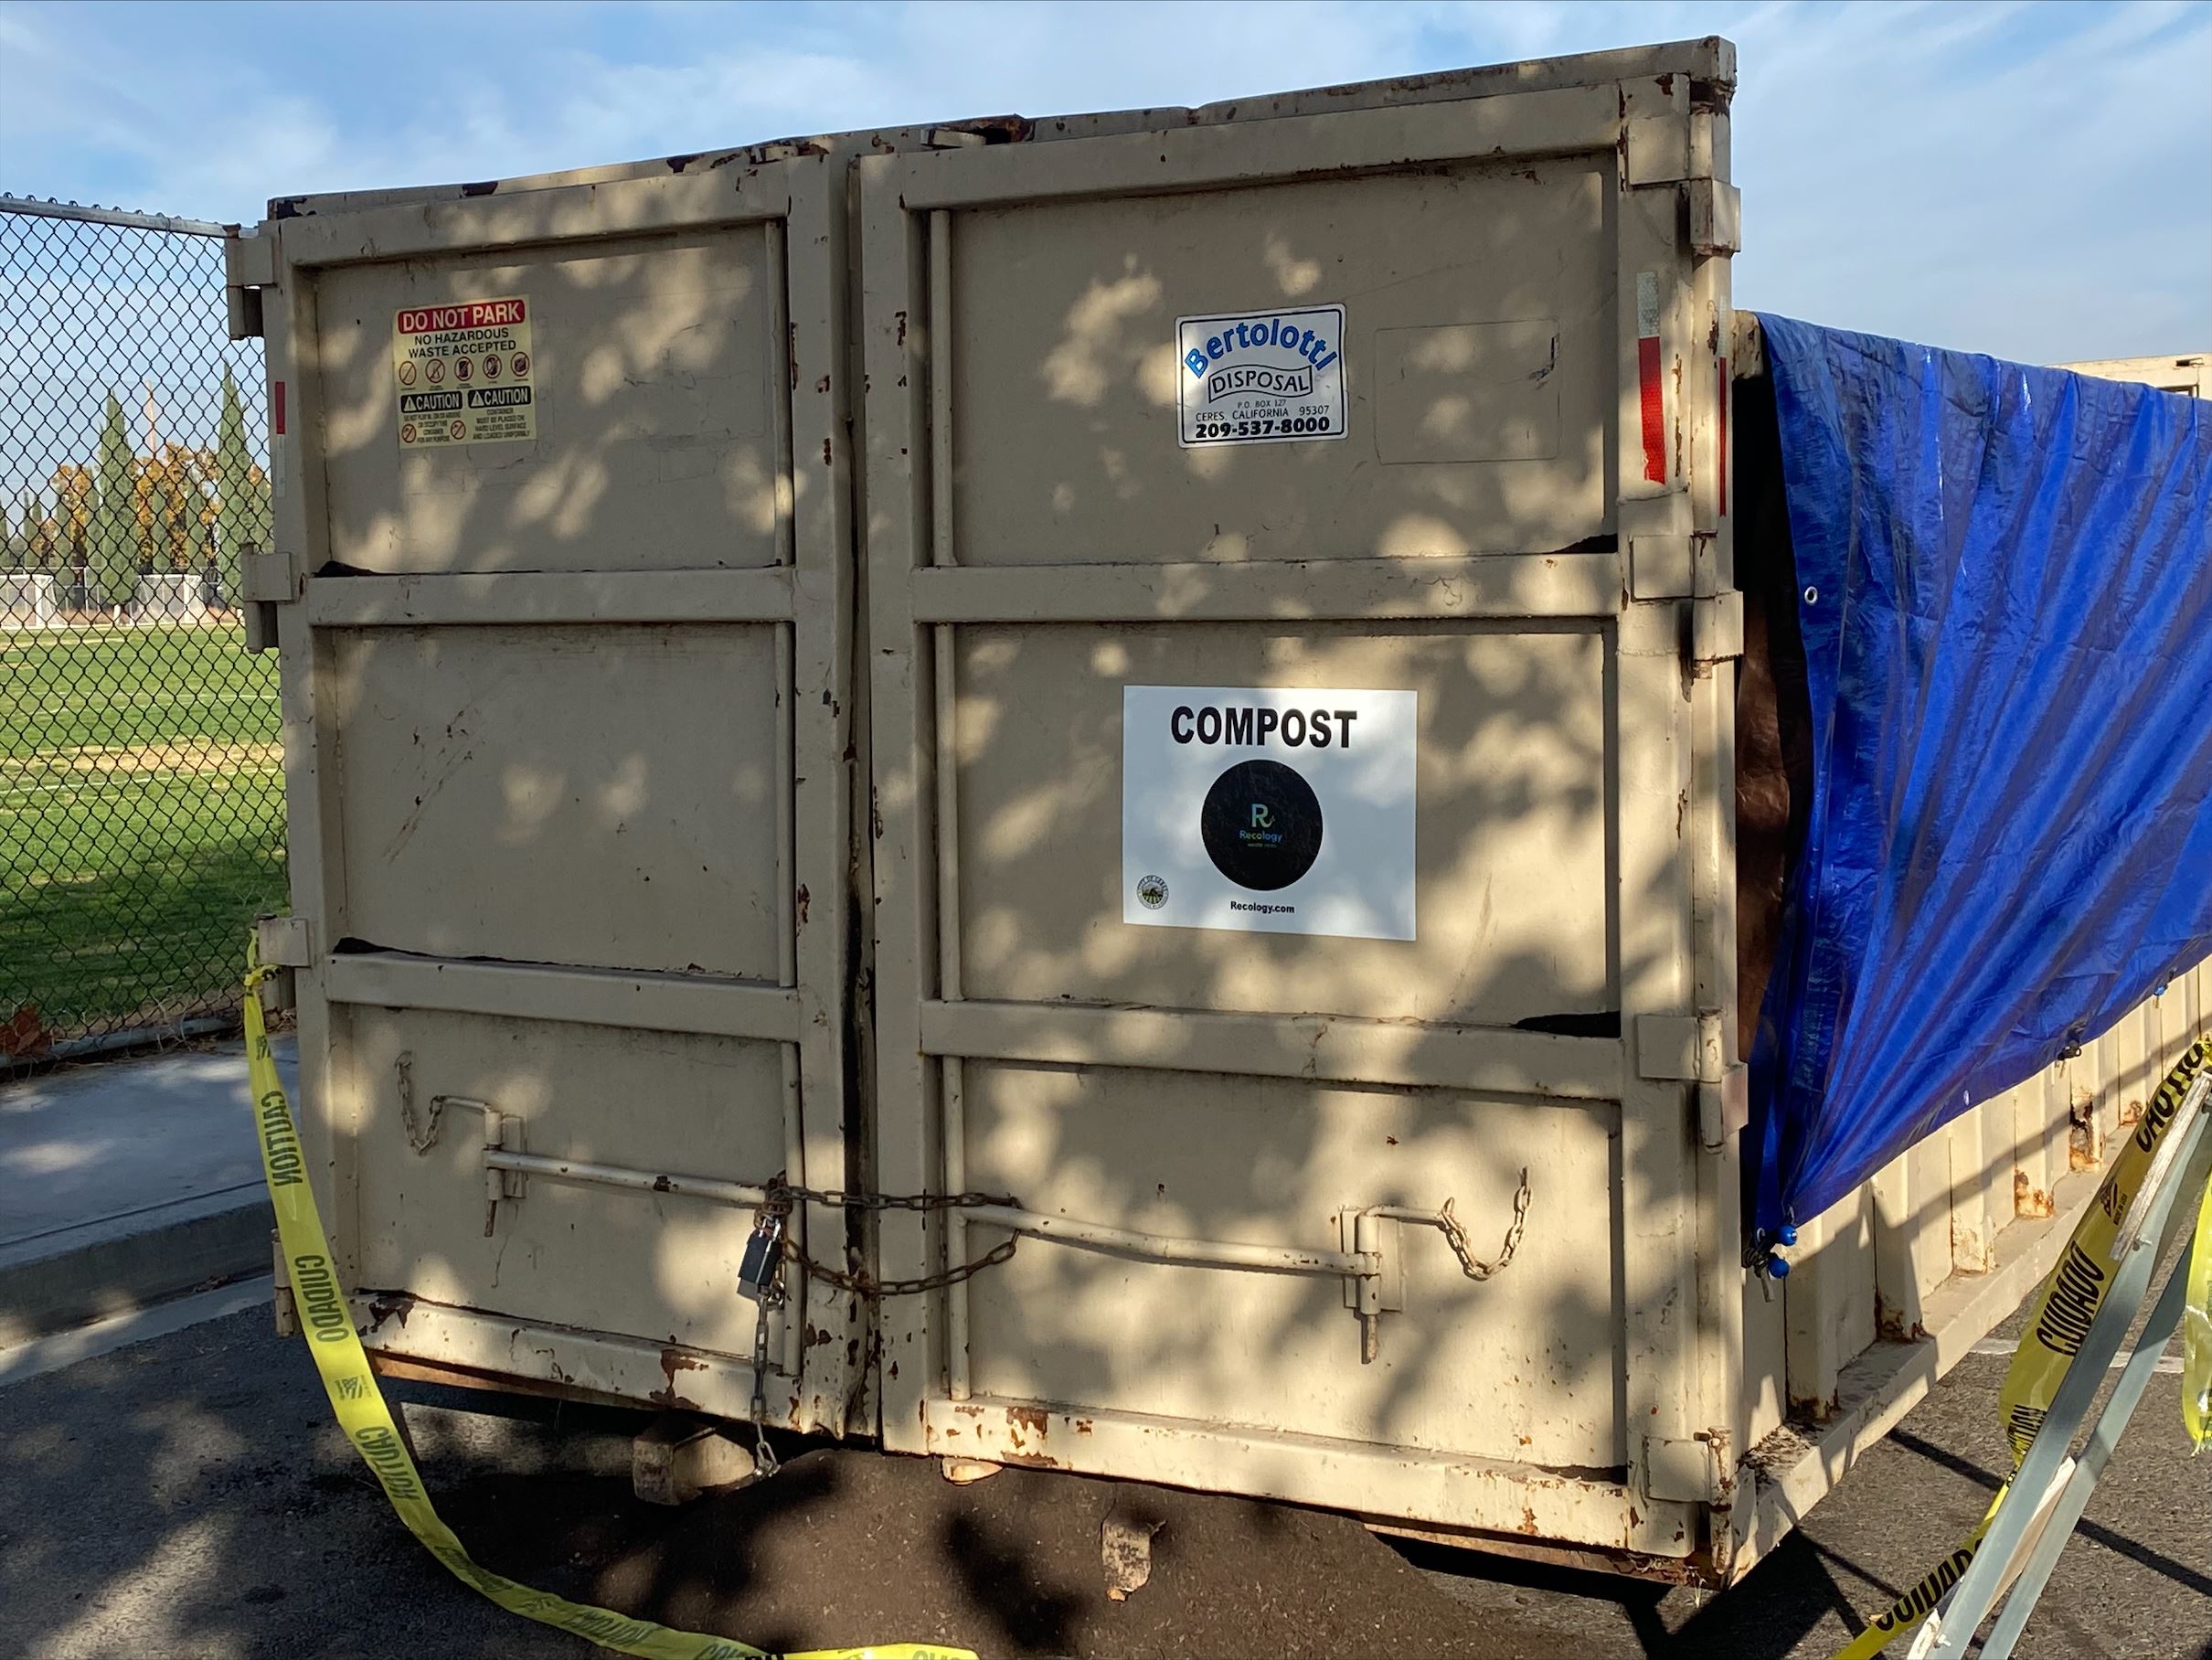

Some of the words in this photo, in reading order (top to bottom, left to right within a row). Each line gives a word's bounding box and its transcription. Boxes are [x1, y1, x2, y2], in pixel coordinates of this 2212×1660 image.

[402, 313, 428, 332] DO
[432, 307, 469, 329] NOT
[473, 302, 521, 325] PARK
[414, 335, 431, 346] NO
[435, 327, 509, 345] HAZARDOUS
[409, 346, 450, 358] WASTE
[452, 340, 516, 356] ACCEPTED
[1185, 318, 1337, 379] Bertolotti
[1211, 370, 1310, 395] DISPOSAL
[416, 393, 460, 410] CAUTION
[484, 388, 528, 406] CAUTION
[1255, 399, 1271, 408] BOX
[1274, 399, 1287, 408] 127
[1232, 408, 1289, 420] CALIFORNIA
[1299, 405, 1330, 416] 95307
[1196, 417, 1330, 439] 209-537-8000
[1171, 706, 1357, 749] COMPOST
[1239, 829, 1282, 844] Recology
[1230, 901, 1295, 914] Recology.com
[2135, 1043, 2205, 1154] CAUTIO
[2037, 1240, 2105, 1356] CUIDADO
[1876, 1538, 1983, 1632] CUIDAD
